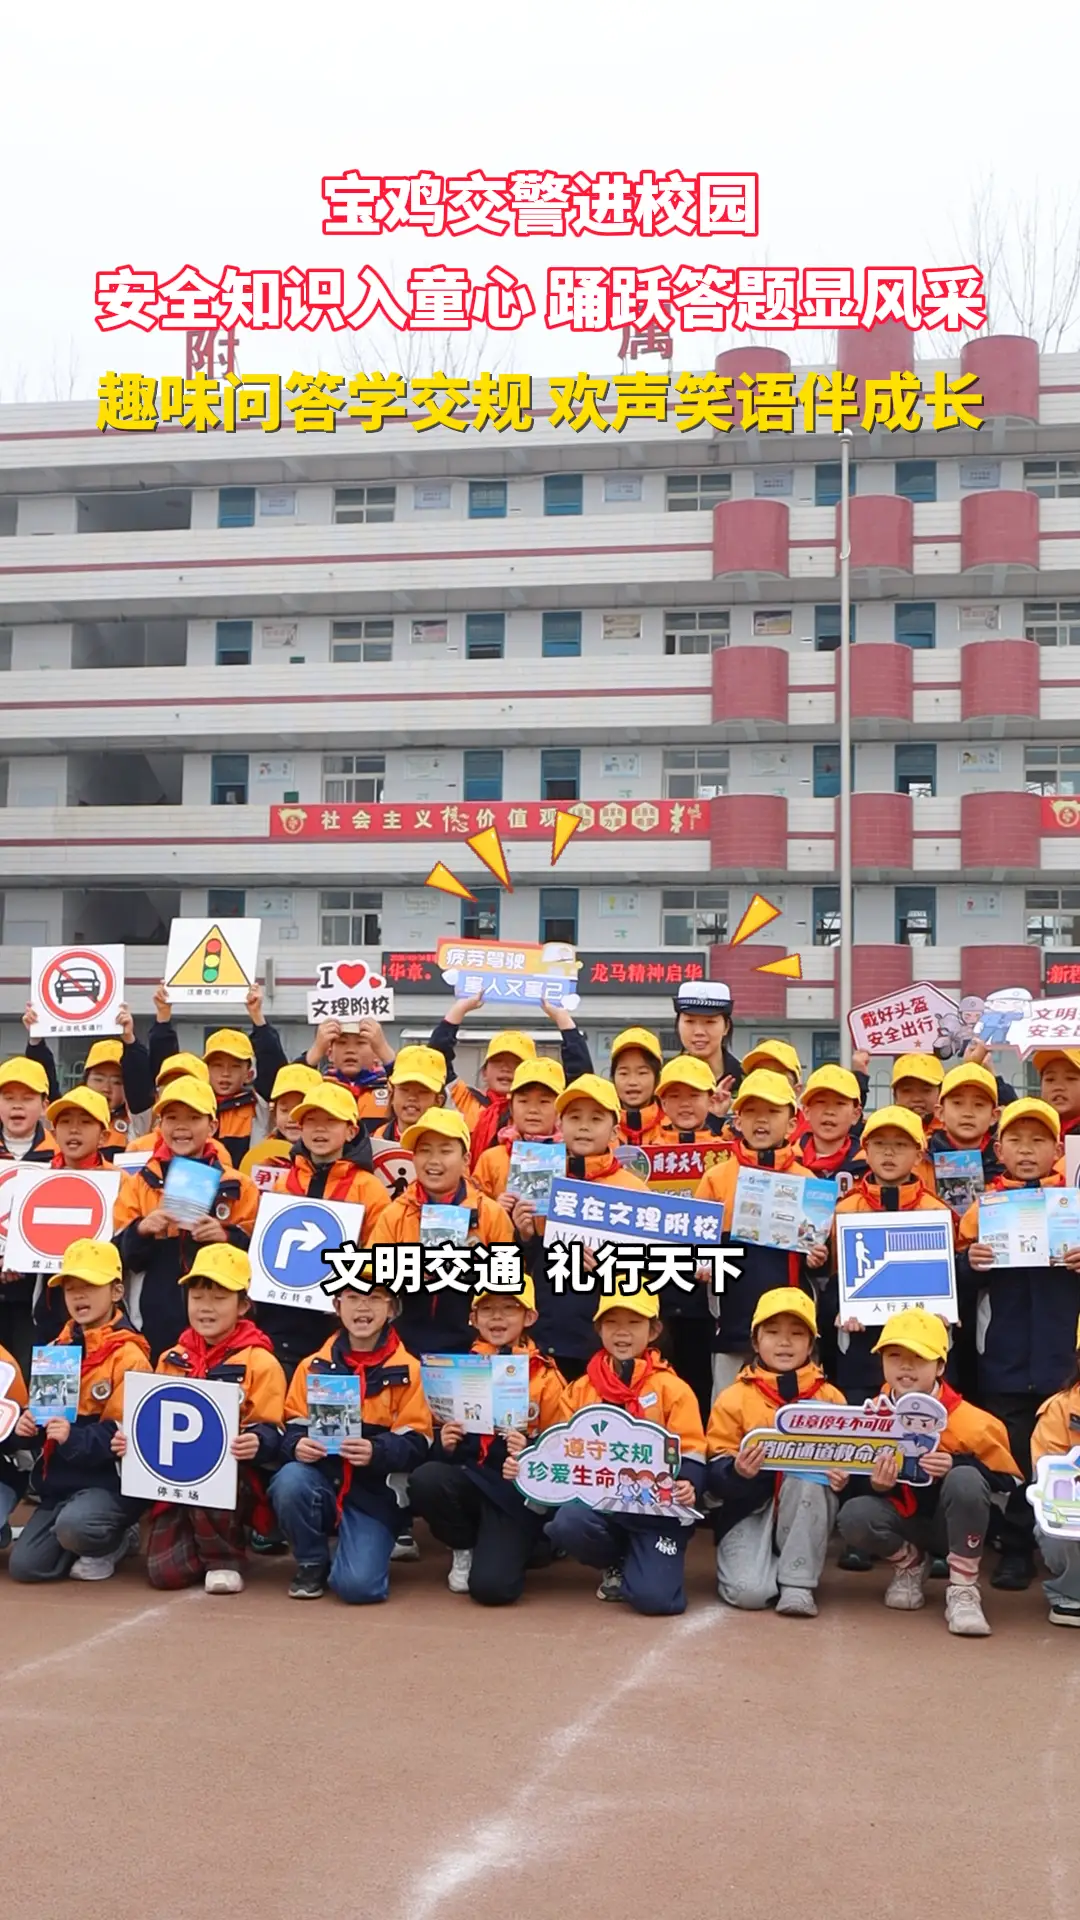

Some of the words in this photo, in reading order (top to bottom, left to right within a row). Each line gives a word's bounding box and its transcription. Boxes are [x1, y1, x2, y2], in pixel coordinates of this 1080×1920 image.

[446, 948, 526, 970] 疲劳驾驶
[320, 966, 334, 989] I
[590, 962, 704, 983] 龙马精神启华
[464, 974, 563, 1000] 害人又害己
[311, 994, 390, 1018] 文理附校
[861, 996, 929, 1029] 戴好头盔
[1031, 1007, 1080, 1021] 文明
[867, 1016, 934, 1048] 安全出行
[554, 1190, 719, 1241] 爱在文理附校
[159, 1400, 203, 1466] P
[788, 1413, 896, 1433] 违章停车不可取
[563, 1438, 653, 1465] 遵守交规
[527, 1461, 616, 1489] 珍爱生命
[157, 1486, 199, 1501] 停车场
